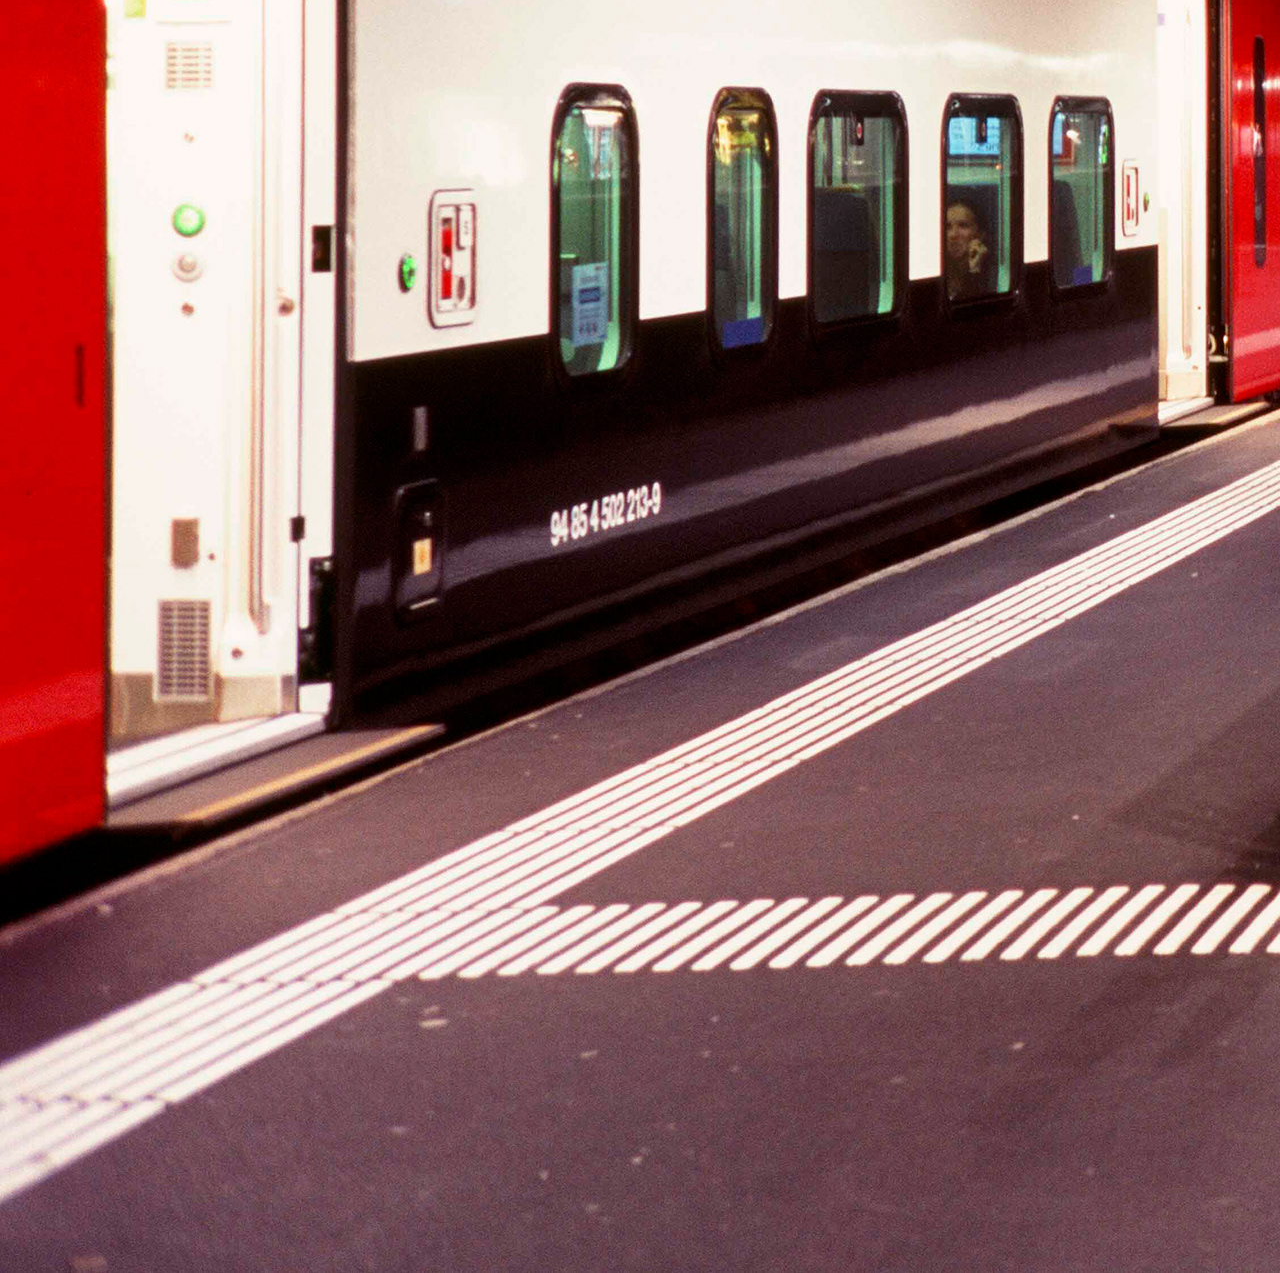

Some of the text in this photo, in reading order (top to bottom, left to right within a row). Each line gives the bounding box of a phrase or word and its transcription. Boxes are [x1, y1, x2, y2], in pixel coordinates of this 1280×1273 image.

[550, 481, 662, 547] 94 85 4 502 213-9
